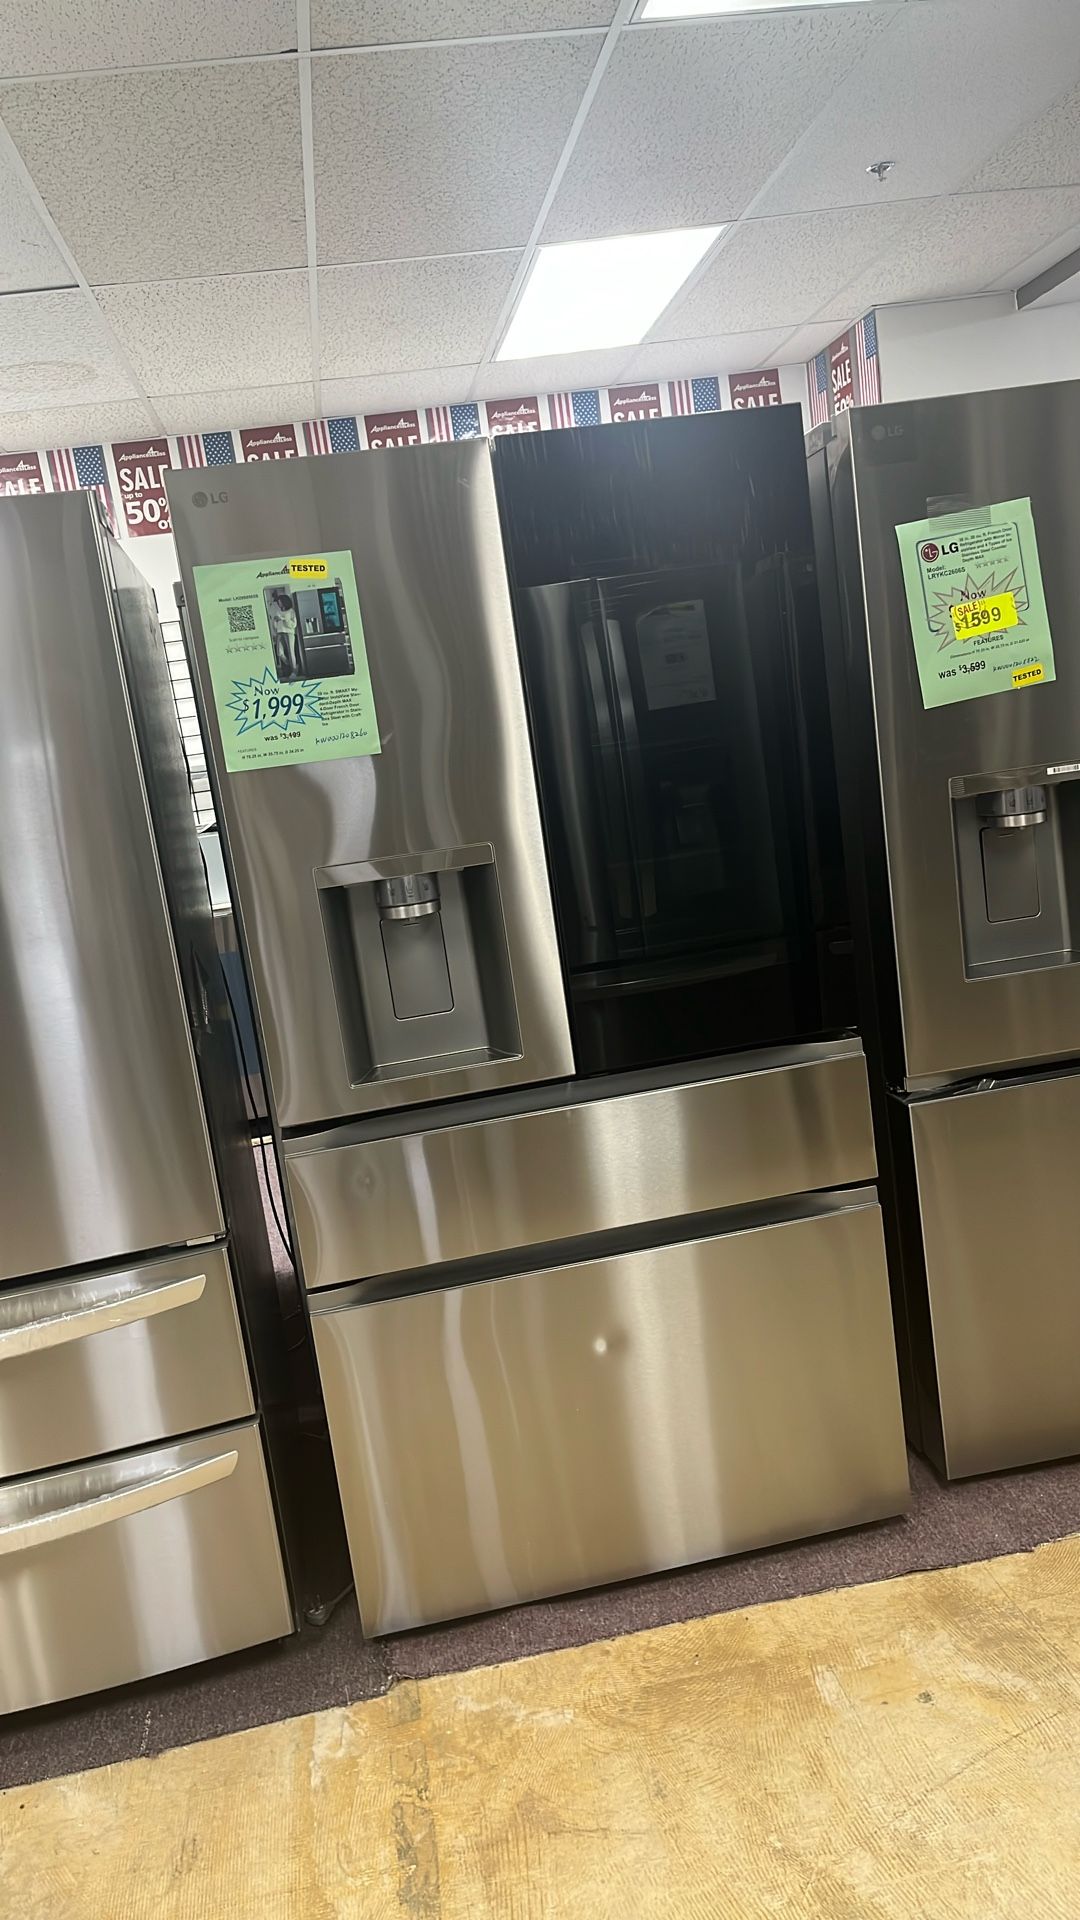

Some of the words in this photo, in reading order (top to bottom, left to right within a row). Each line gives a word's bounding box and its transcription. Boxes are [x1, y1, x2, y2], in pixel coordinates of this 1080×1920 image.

[832, 359, 851, 393] SALE
[210, 491, 229, 504] LG
[941, 542, 959, 556] LG
[291, 564, 326, 572] TESTED
[960, 590, 986, 602] Now
[957, 601, 979, 617] SALE
[955, 606, 1001, 632] $1599
[938, 668, 957, 679] was
[1013, 669, 1042, 682] TESTED
[254, 686, 280, 696] Now
[242, 694, 304, 720] $1,999
[264, 734, 279, 742] was
